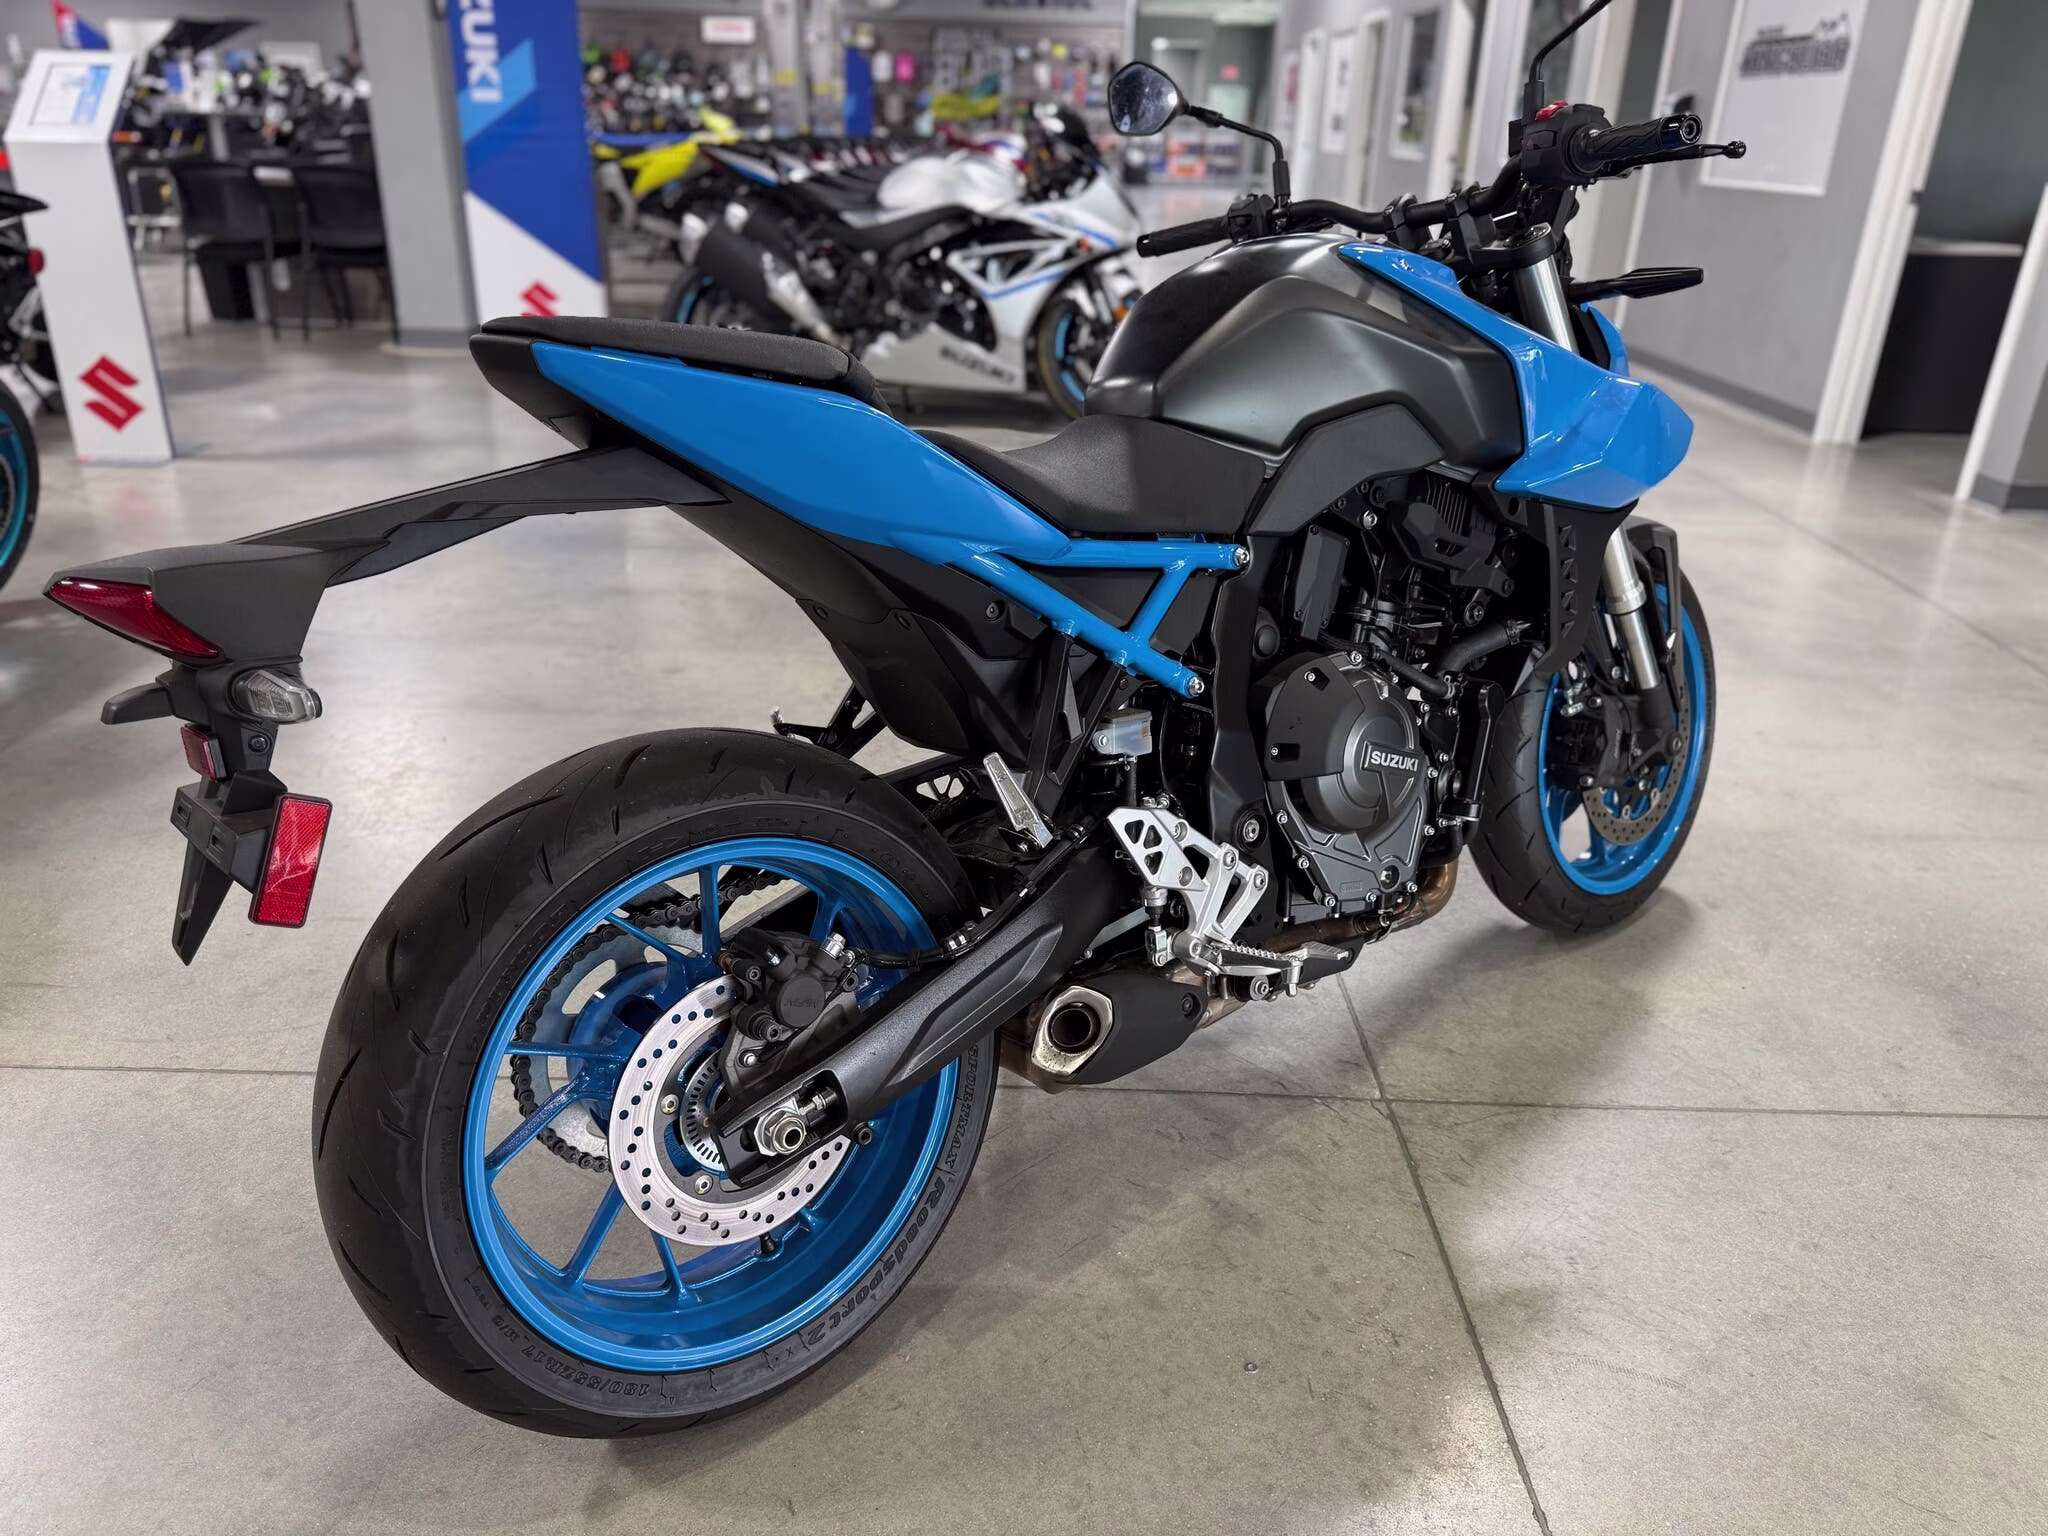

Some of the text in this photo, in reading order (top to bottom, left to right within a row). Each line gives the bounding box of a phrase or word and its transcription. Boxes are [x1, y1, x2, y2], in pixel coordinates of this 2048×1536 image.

[1370, 750, 1419, 772] SUZUKI
[945, 1041, 979, 1169] SPORTMAX
[807, 1176, 946, 1346] Roadsport 2
[521, 1344, 650, 1397] 180/55ZR17
